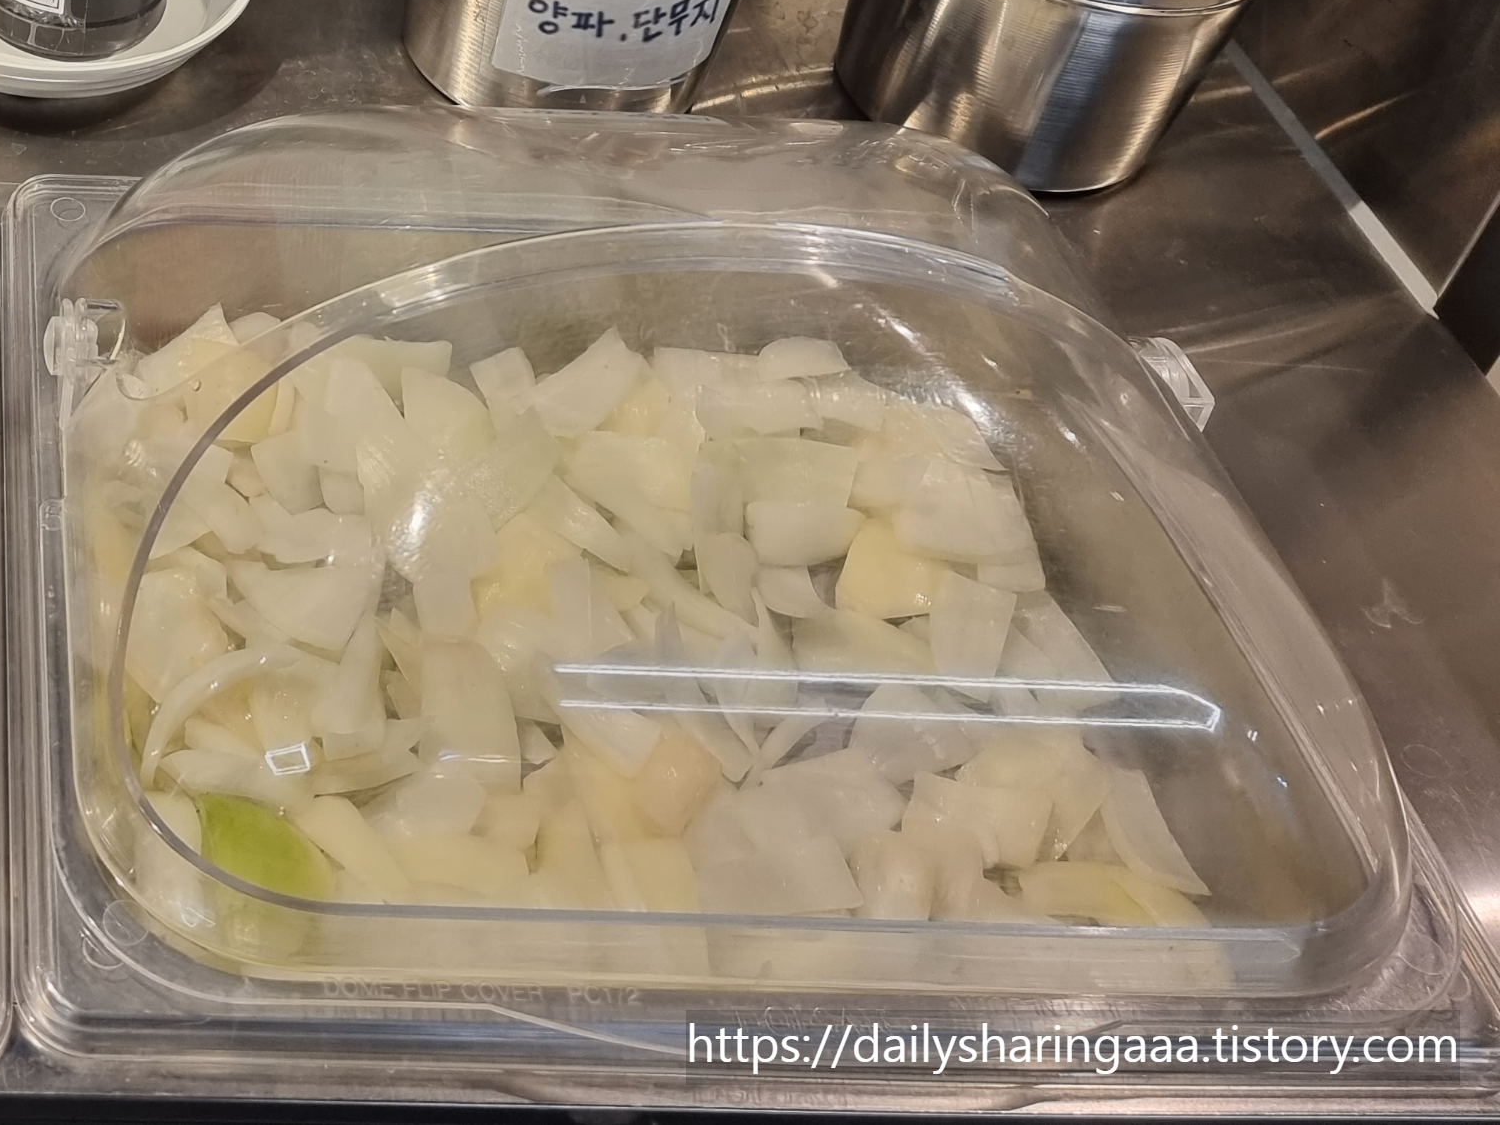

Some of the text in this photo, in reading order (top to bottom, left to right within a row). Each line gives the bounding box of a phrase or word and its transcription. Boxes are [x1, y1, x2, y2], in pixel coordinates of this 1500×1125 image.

[323, 977, 394, 998] DOME
[400, 979, 451, 999] FLIP
[460, 981, 544, 1003] COVER
